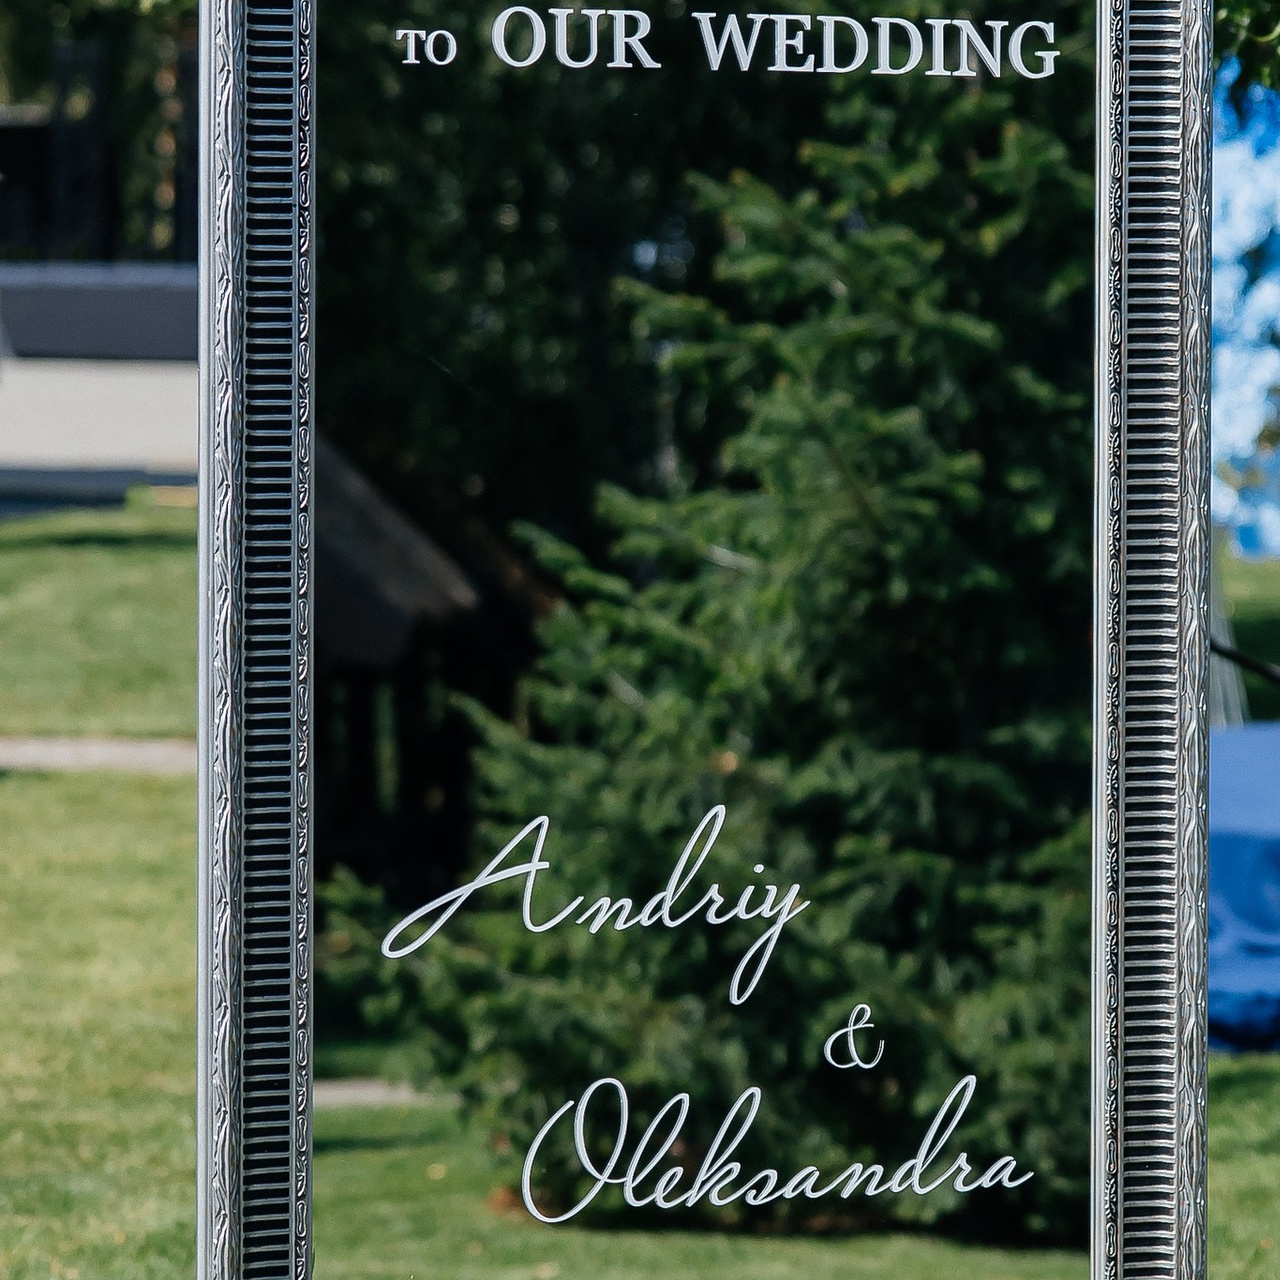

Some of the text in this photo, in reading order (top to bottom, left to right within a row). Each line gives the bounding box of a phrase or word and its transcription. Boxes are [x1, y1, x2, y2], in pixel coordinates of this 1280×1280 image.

[396, 6, 1061, 80] TO OUR WEDDING
[381, 804, 811, 1006] Andriy
[824, 1003, 885, 1069] &
[521, 1074, 1034, 1224] Oleksandra
